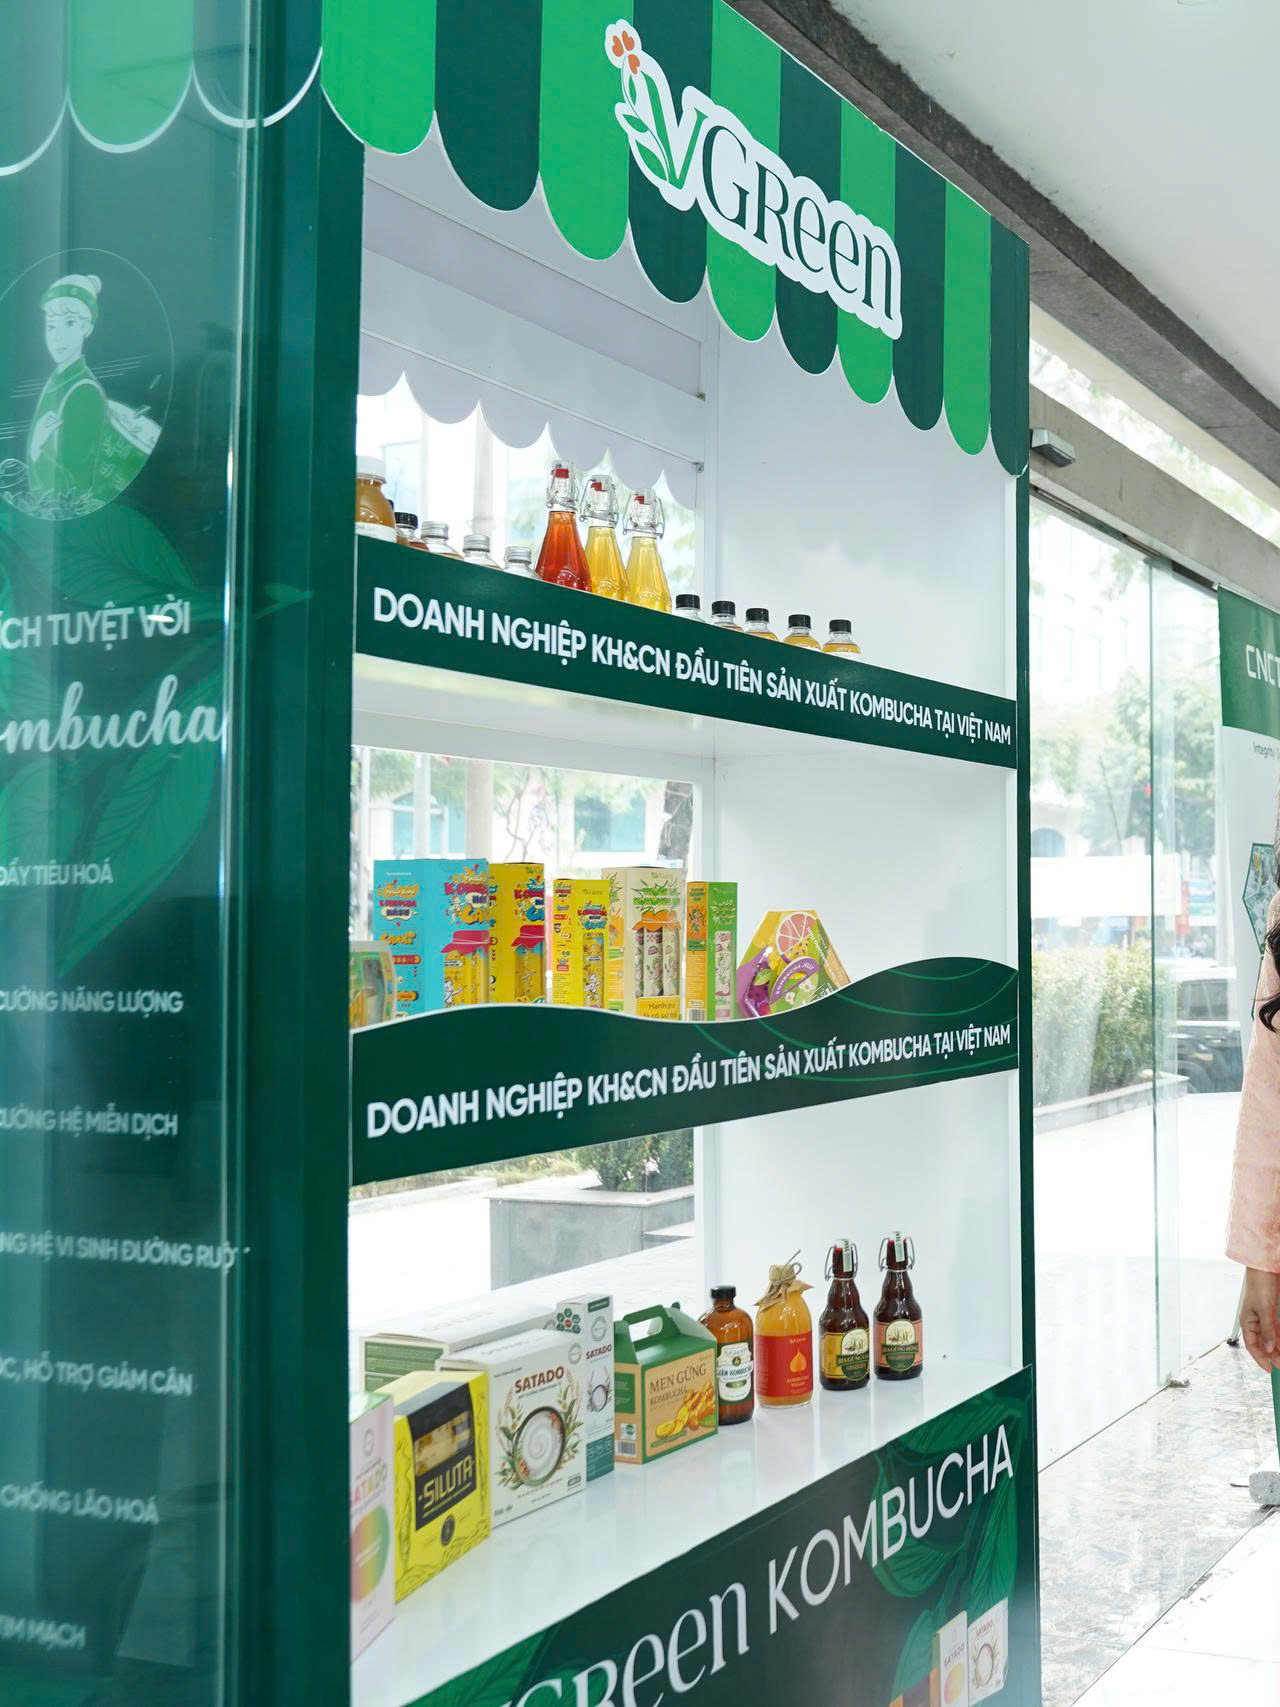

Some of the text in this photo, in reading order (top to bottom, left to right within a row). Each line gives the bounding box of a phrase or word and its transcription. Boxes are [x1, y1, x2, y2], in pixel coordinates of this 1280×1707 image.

[0, 594, 191, 650] CH TUYỆT VỜI
[373, 587, 1011, 745] DOANH NGHIỆP KH&CN ĐẦU TIÊN SẢN XUẤT KOMBUCHA TẠI VIỆT NAM
[0, 674, 227, 753] mbucha
[33, 859, 70, 885] TIÊU
[73, 858, 113, 885] HOÁ
[62, 986, 115, 1012] NĂNG
[118, 989, 184, 1018] LƯỢNG
[367, 1024, 1010, 1139] DOANH NGHIỆP KH&CN ĐẦU TIÊN SẢN XUẤT KOMBUCHA TẠI VIỆT NAM
[60, 1105, 83, 1138] HỆ
[85, 1102, 129, 1134] MIỄN
[132, 1113, 178, 1141] DỊCH
[0, 1231, 27, 1254] NG
[29, 1230, 52, 1261] HỆ
[56, 1235, 74, 1257] VI
[77, 1236, 118, 1261] SINH
[121, 1235, 193, 1267] ĐƯỜNG
[585, 1344, 612, 1360] SATADO
[56, 1361, 94, 1392] TRỢ
[98, 1360, 148, 1391] GIẢM
[151, 1366, 192, 1397] CÂN
[515, 1366, 564, 1394] SATADO
[650, 1374, 674, 1394] MEN
[423, 1454, 473, 1510] SILUTA
[1, 1480, 160, 1525] CHỐNG LÃO HOÁ
[768, 1424, 1015, 1636] KOMBUCHA
